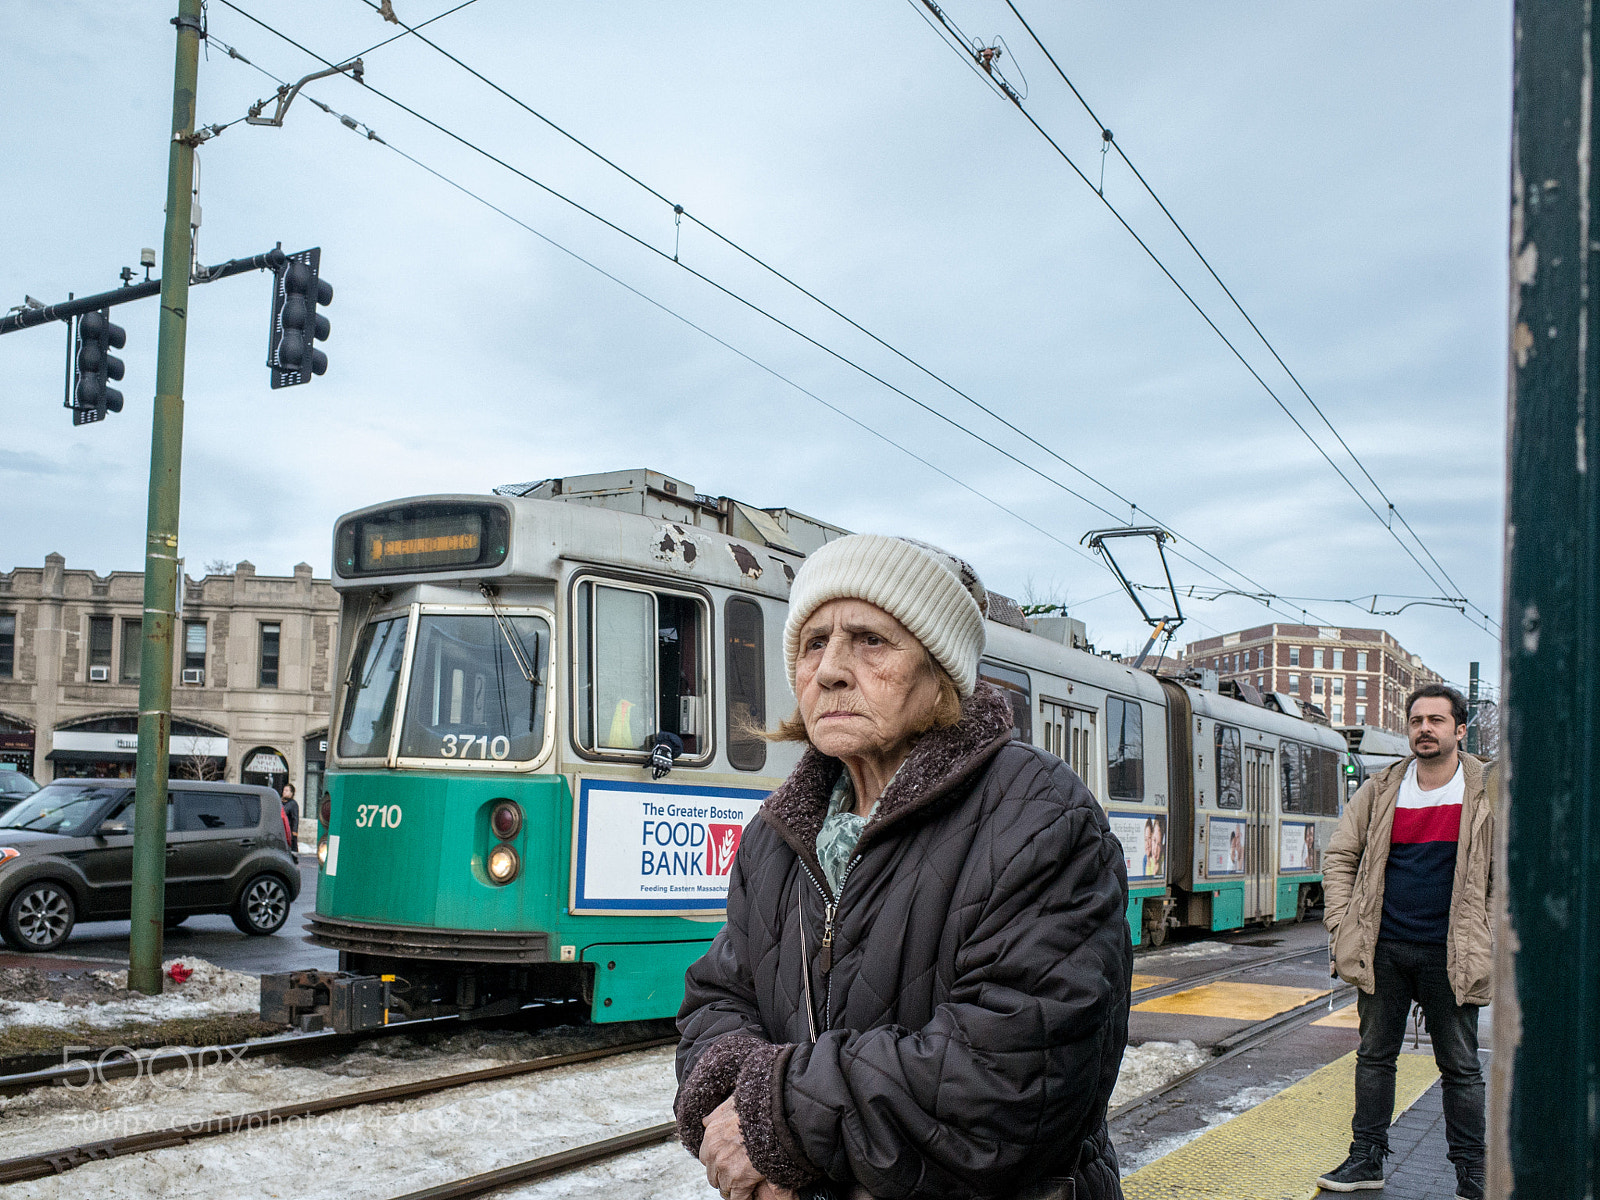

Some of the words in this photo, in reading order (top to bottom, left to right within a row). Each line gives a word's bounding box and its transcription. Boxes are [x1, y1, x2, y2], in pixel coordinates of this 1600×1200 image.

[440, 733, 510, 760] 3710
[356, 804, 402, 829] 3710
[643, 803, 665, 816] The
[667, 804, 708, 818] Greater
[710, 806, 744, 820] Boston
[642, 821, 706, 847] FOOD
[641, 851, 704, 876] BANK
[640, 885, 668, 893] Feeding
